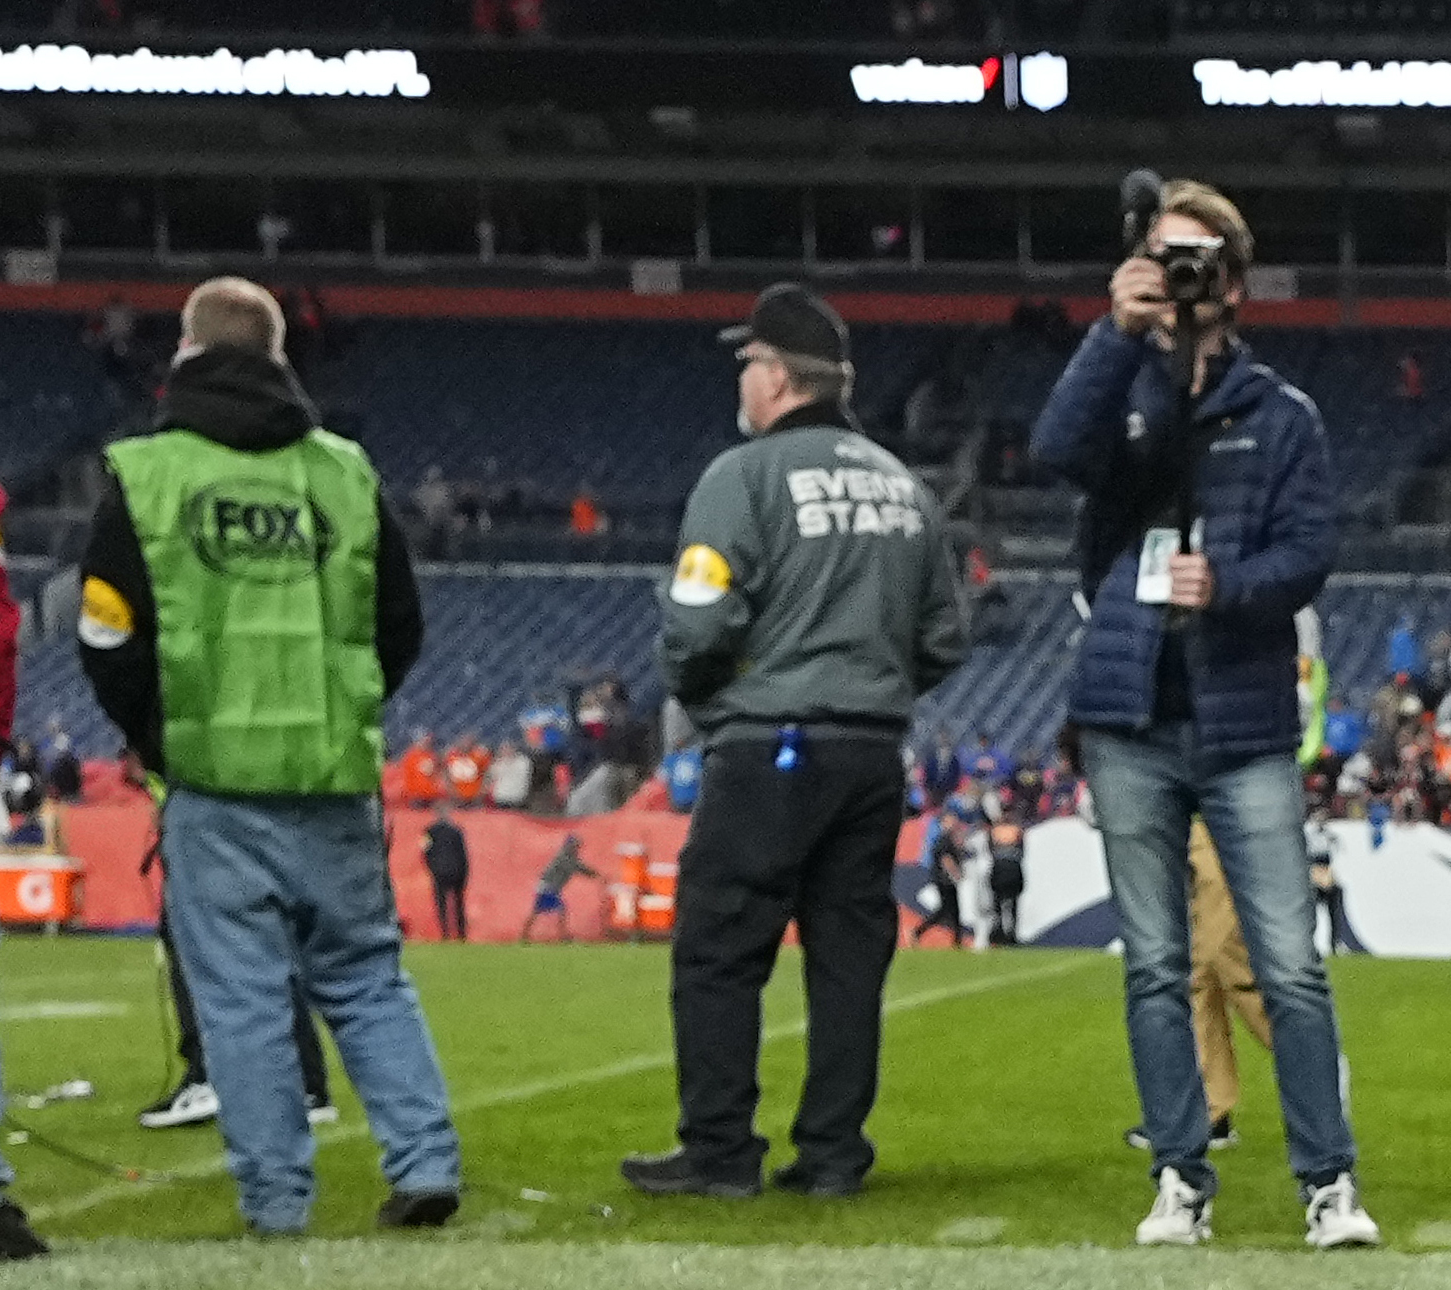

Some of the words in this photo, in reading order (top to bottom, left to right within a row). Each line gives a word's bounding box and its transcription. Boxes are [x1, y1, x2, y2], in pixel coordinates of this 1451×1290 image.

[786, 468, 916, 505] EVENT
[215, 497, 310, 546] FOX
[796, 500, 925, 539] STAFF
